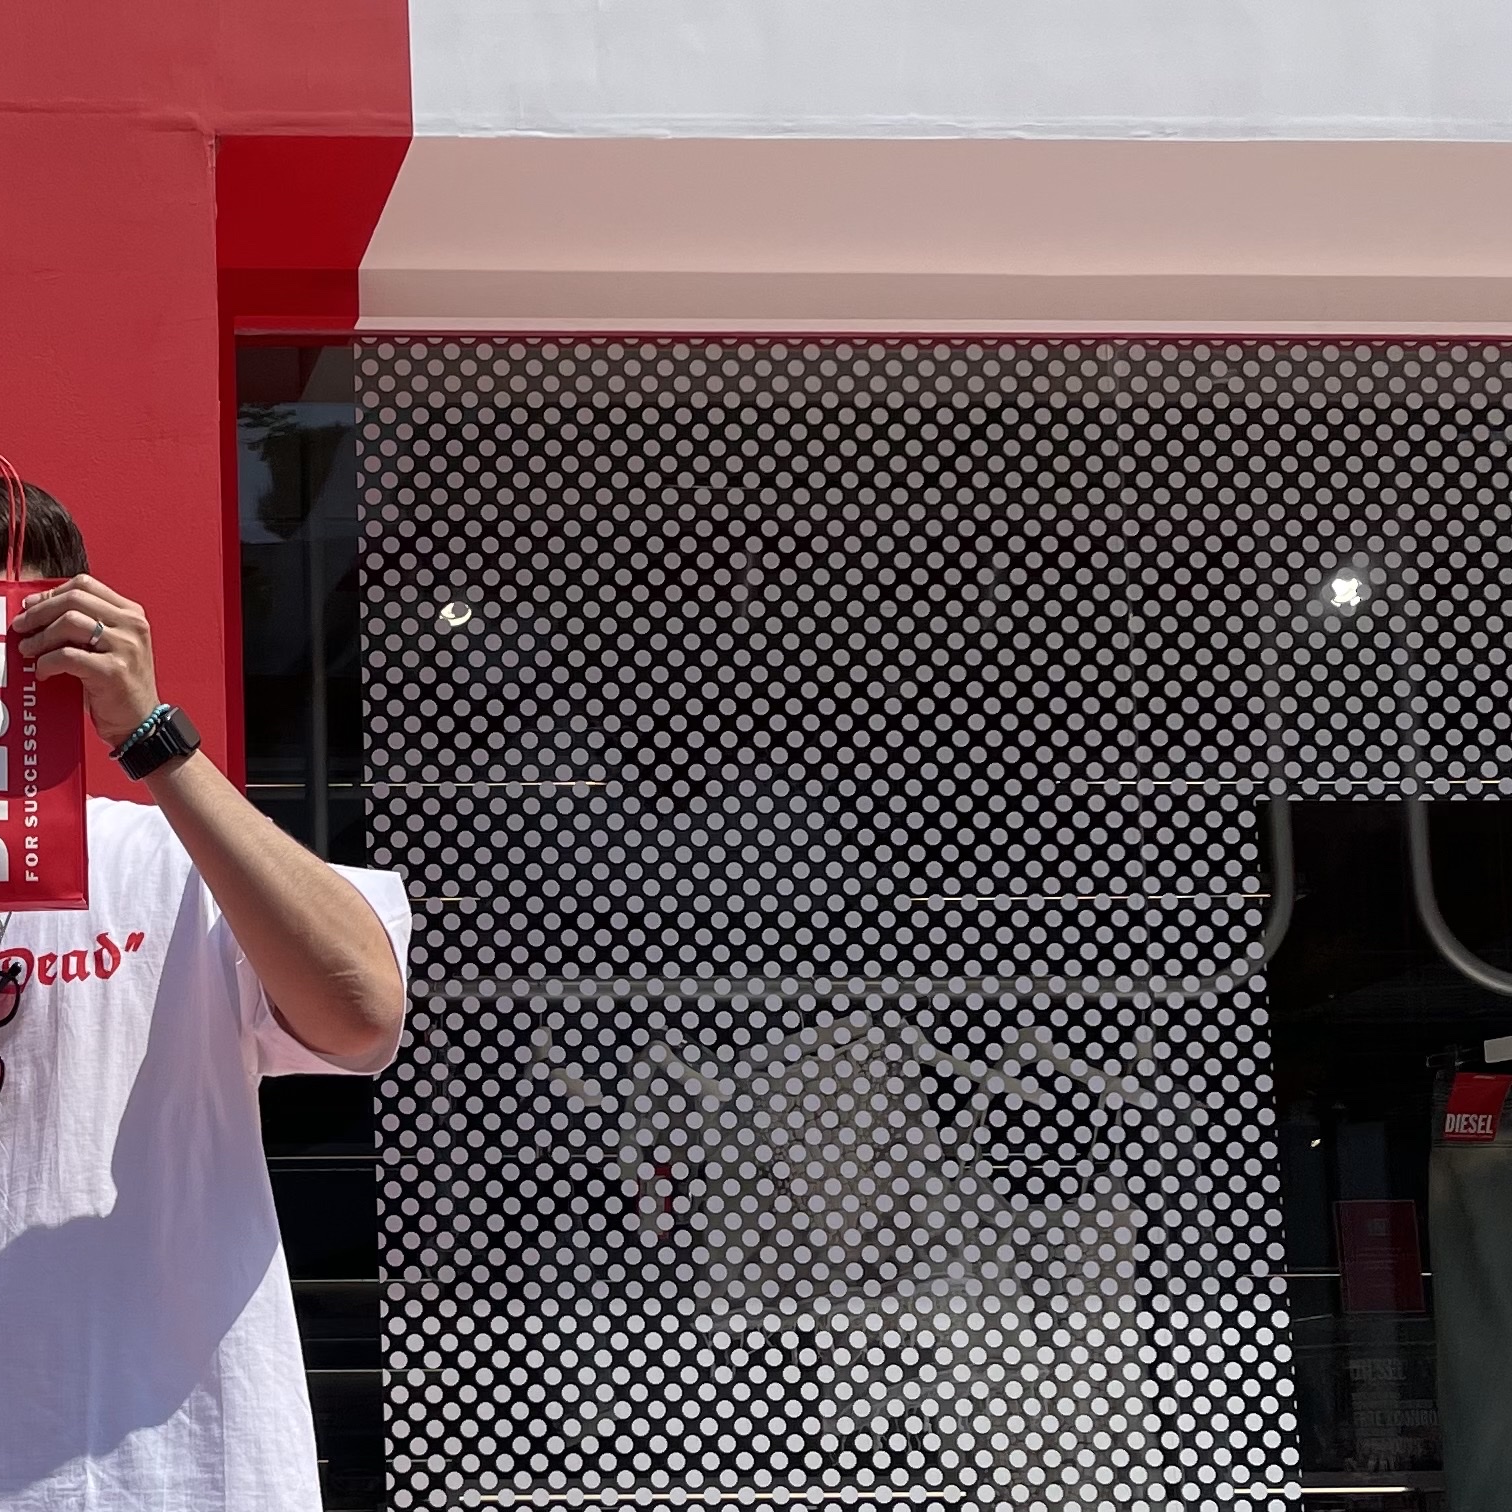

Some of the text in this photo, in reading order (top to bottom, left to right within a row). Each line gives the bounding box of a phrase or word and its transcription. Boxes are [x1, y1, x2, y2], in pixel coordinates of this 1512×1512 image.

[22, 680, 38, 828] SUCCESSFUL
[24, 835, 39, 882] FOR
[1444, 1113, 1494, 1134] DIESEL
